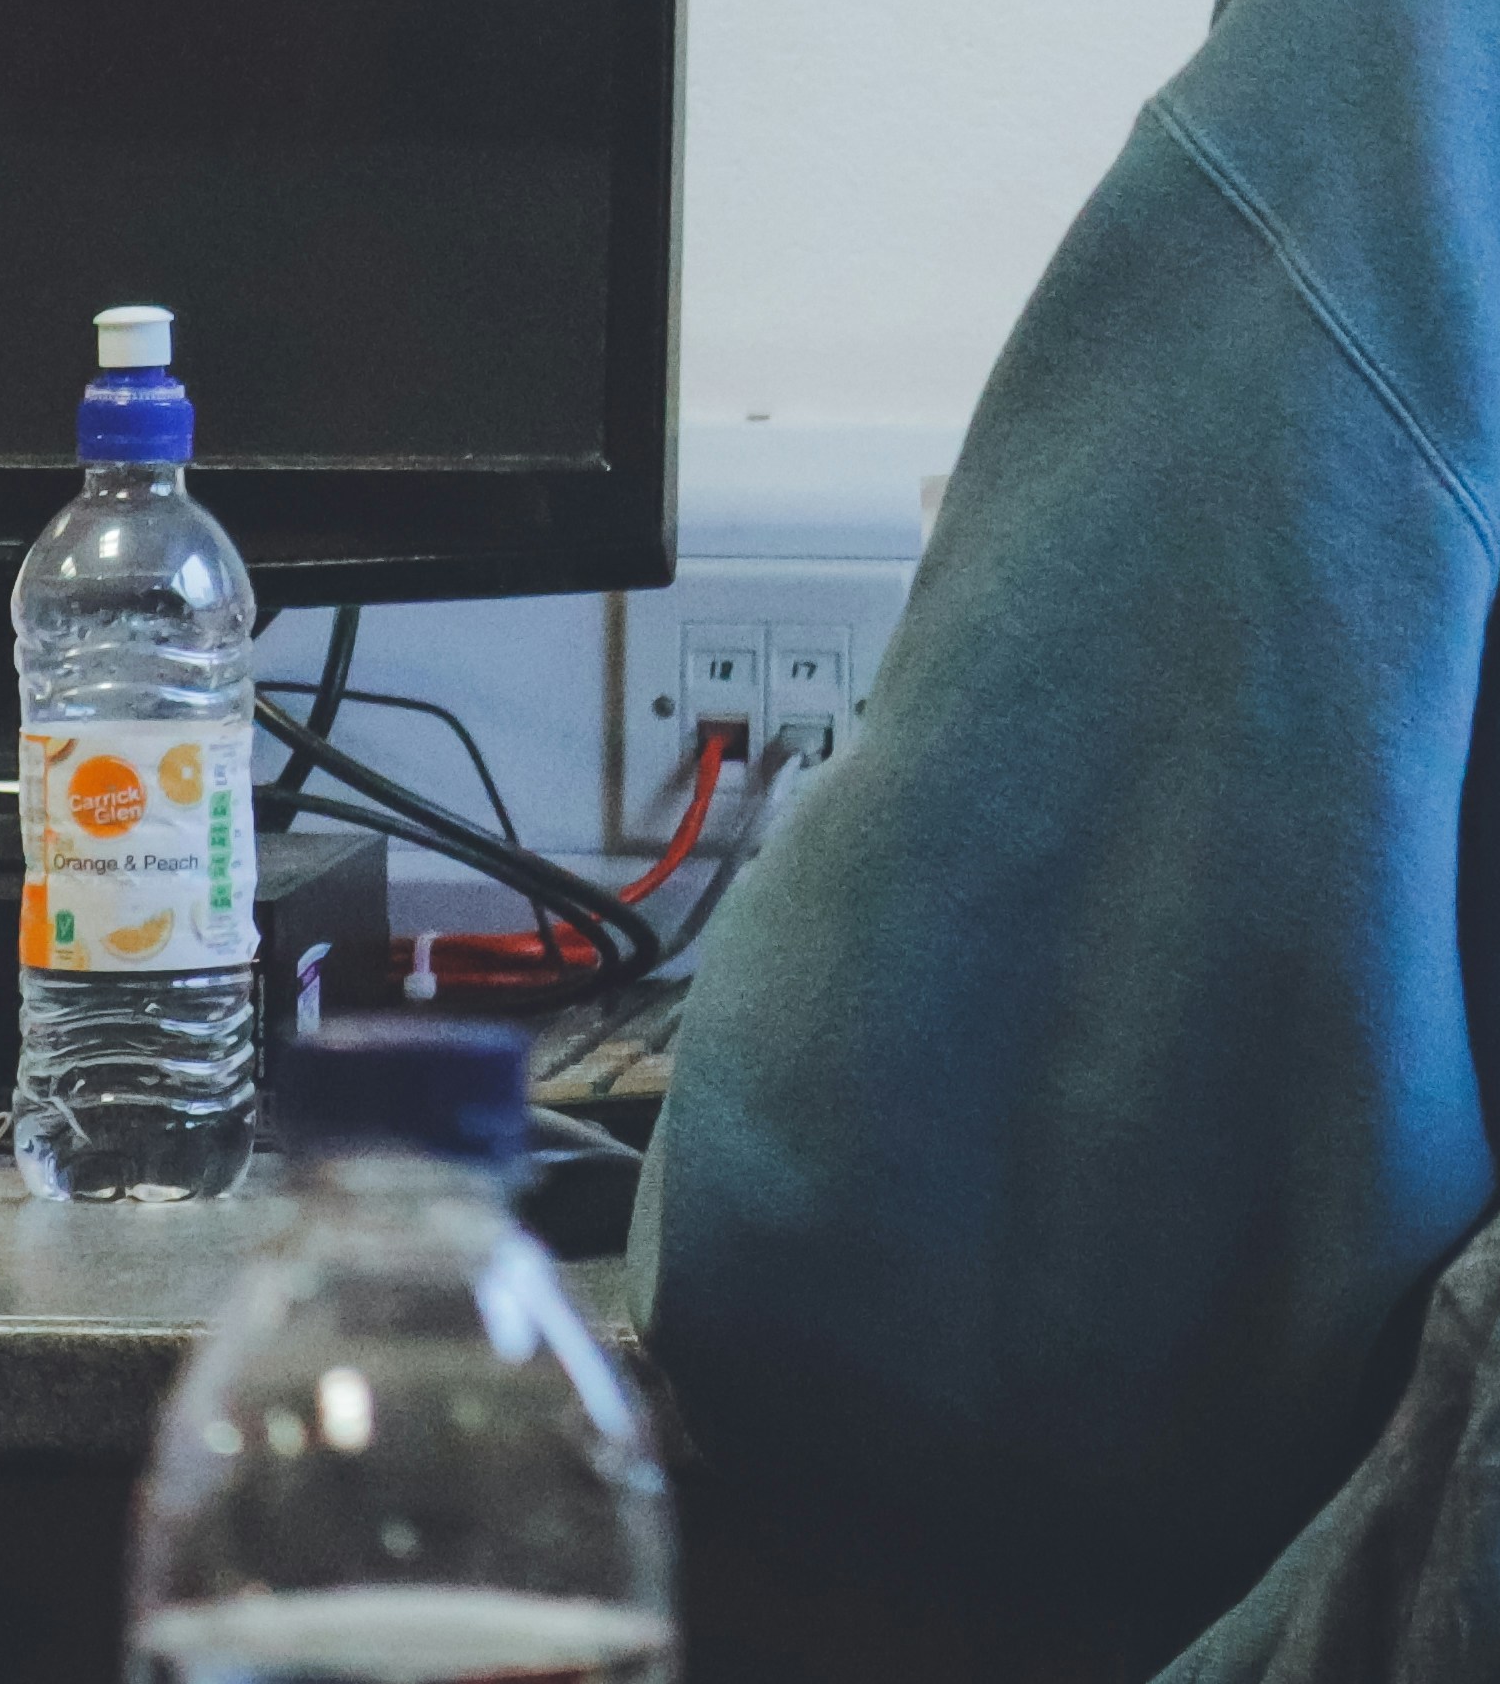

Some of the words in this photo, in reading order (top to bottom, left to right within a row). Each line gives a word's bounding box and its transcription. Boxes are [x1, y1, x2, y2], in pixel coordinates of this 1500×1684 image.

[70, 786, 141, 812] Carrick
[94, 804, 142, 824] Glen
[53, 853, 118, 875] Orange
[124, 854, 137, 871] &
[144, 854, 199, 871] Peach
